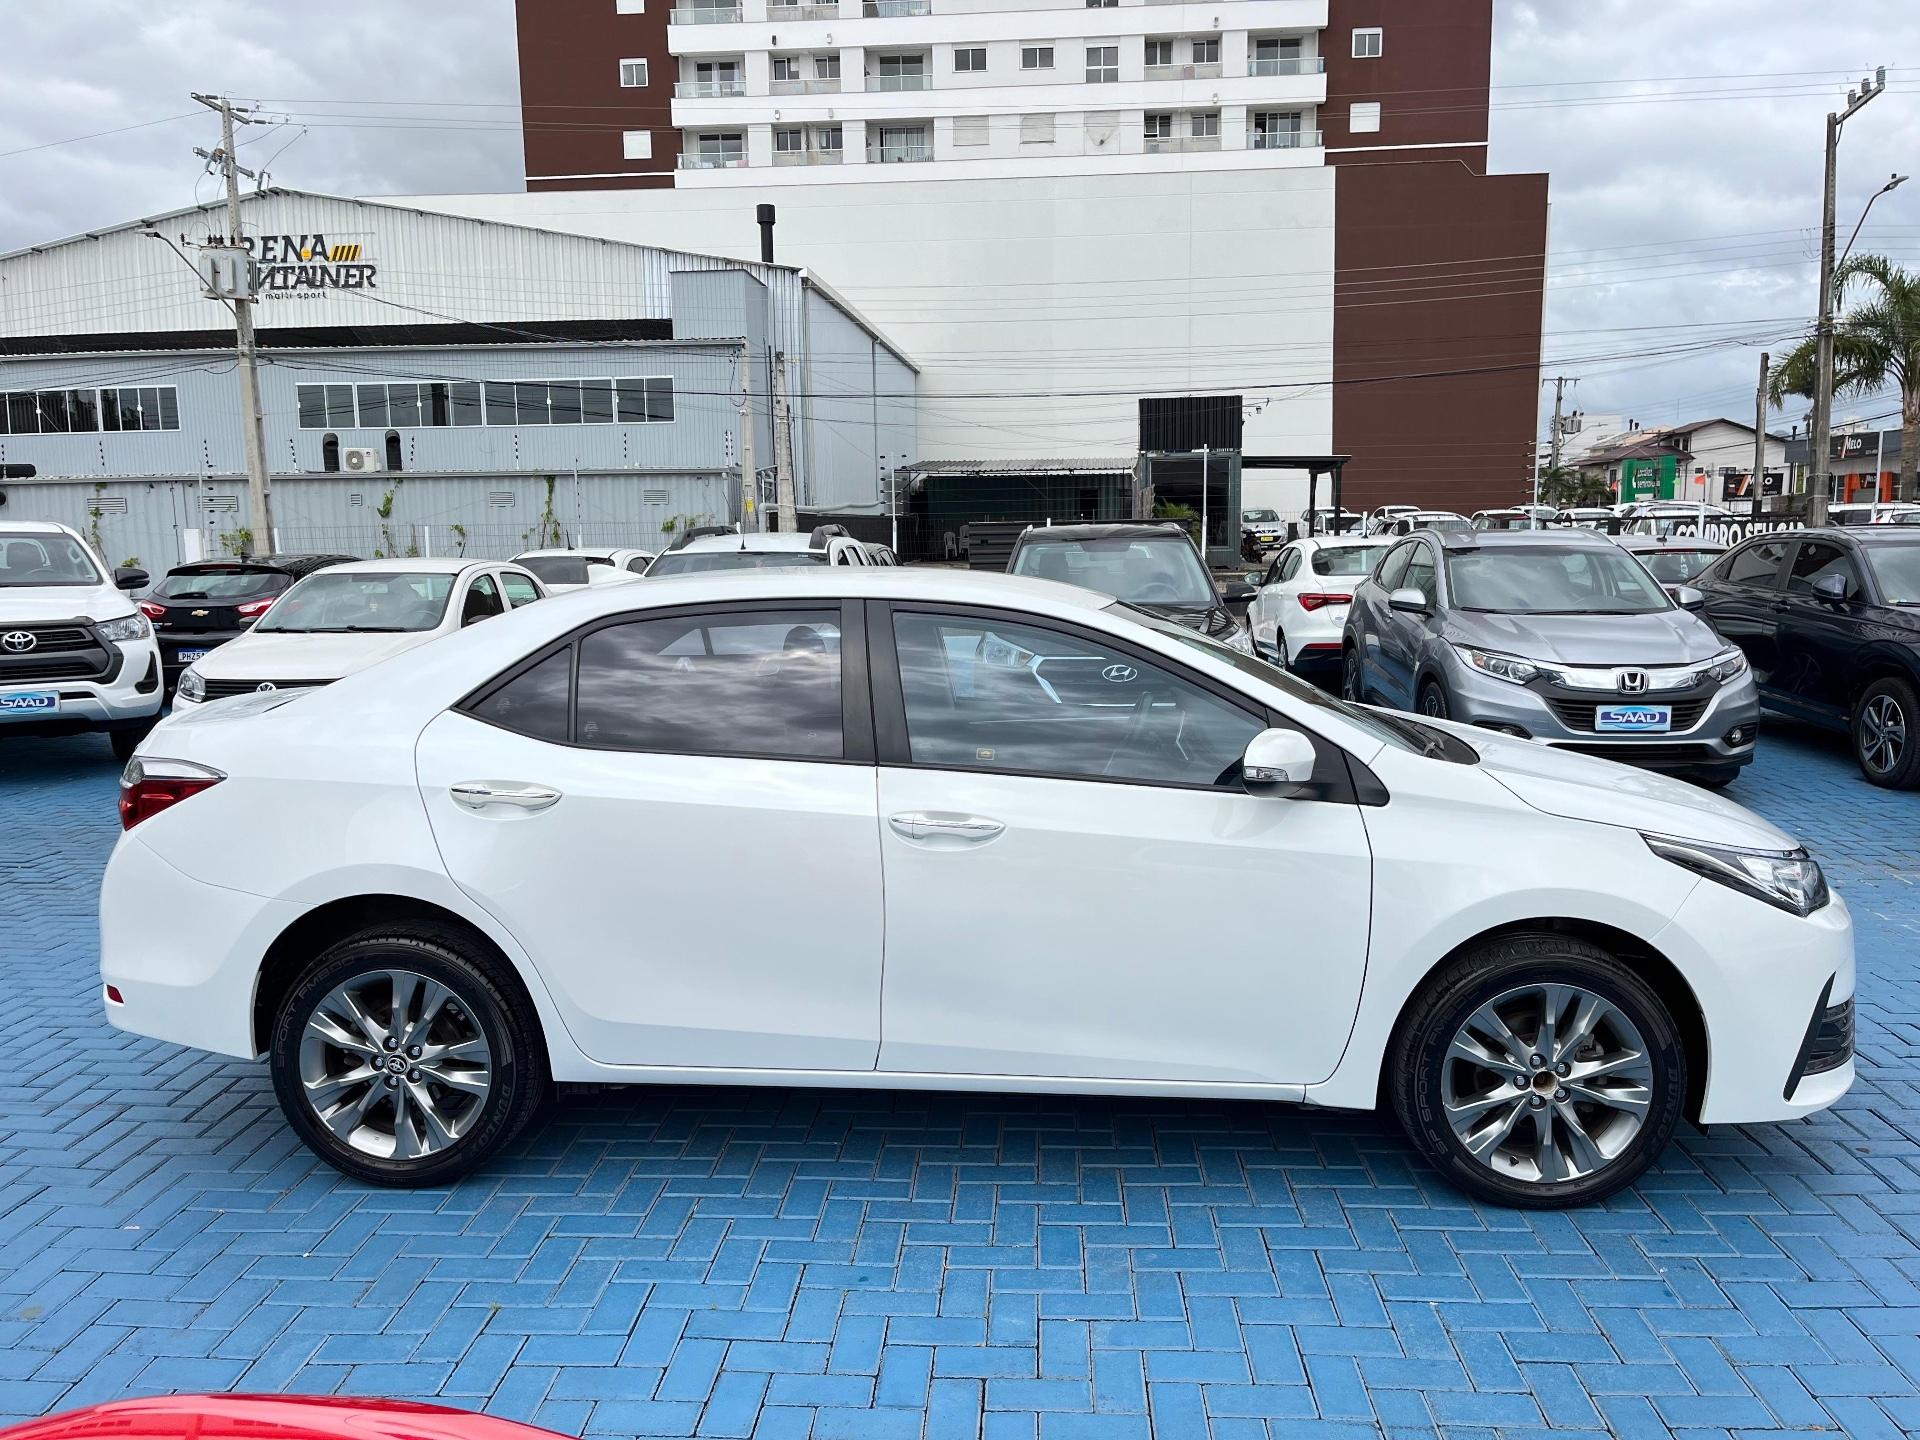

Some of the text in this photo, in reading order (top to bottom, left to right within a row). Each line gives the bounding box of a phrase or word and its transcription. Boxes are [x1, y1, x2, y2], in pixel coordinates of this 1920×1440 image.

[297, 291, 327, 300] sport
[1746, 475, 1773, 486] MO
[0, 696, 48, 708] SAAD
[1610, 711, 1660, 723] SAAD
